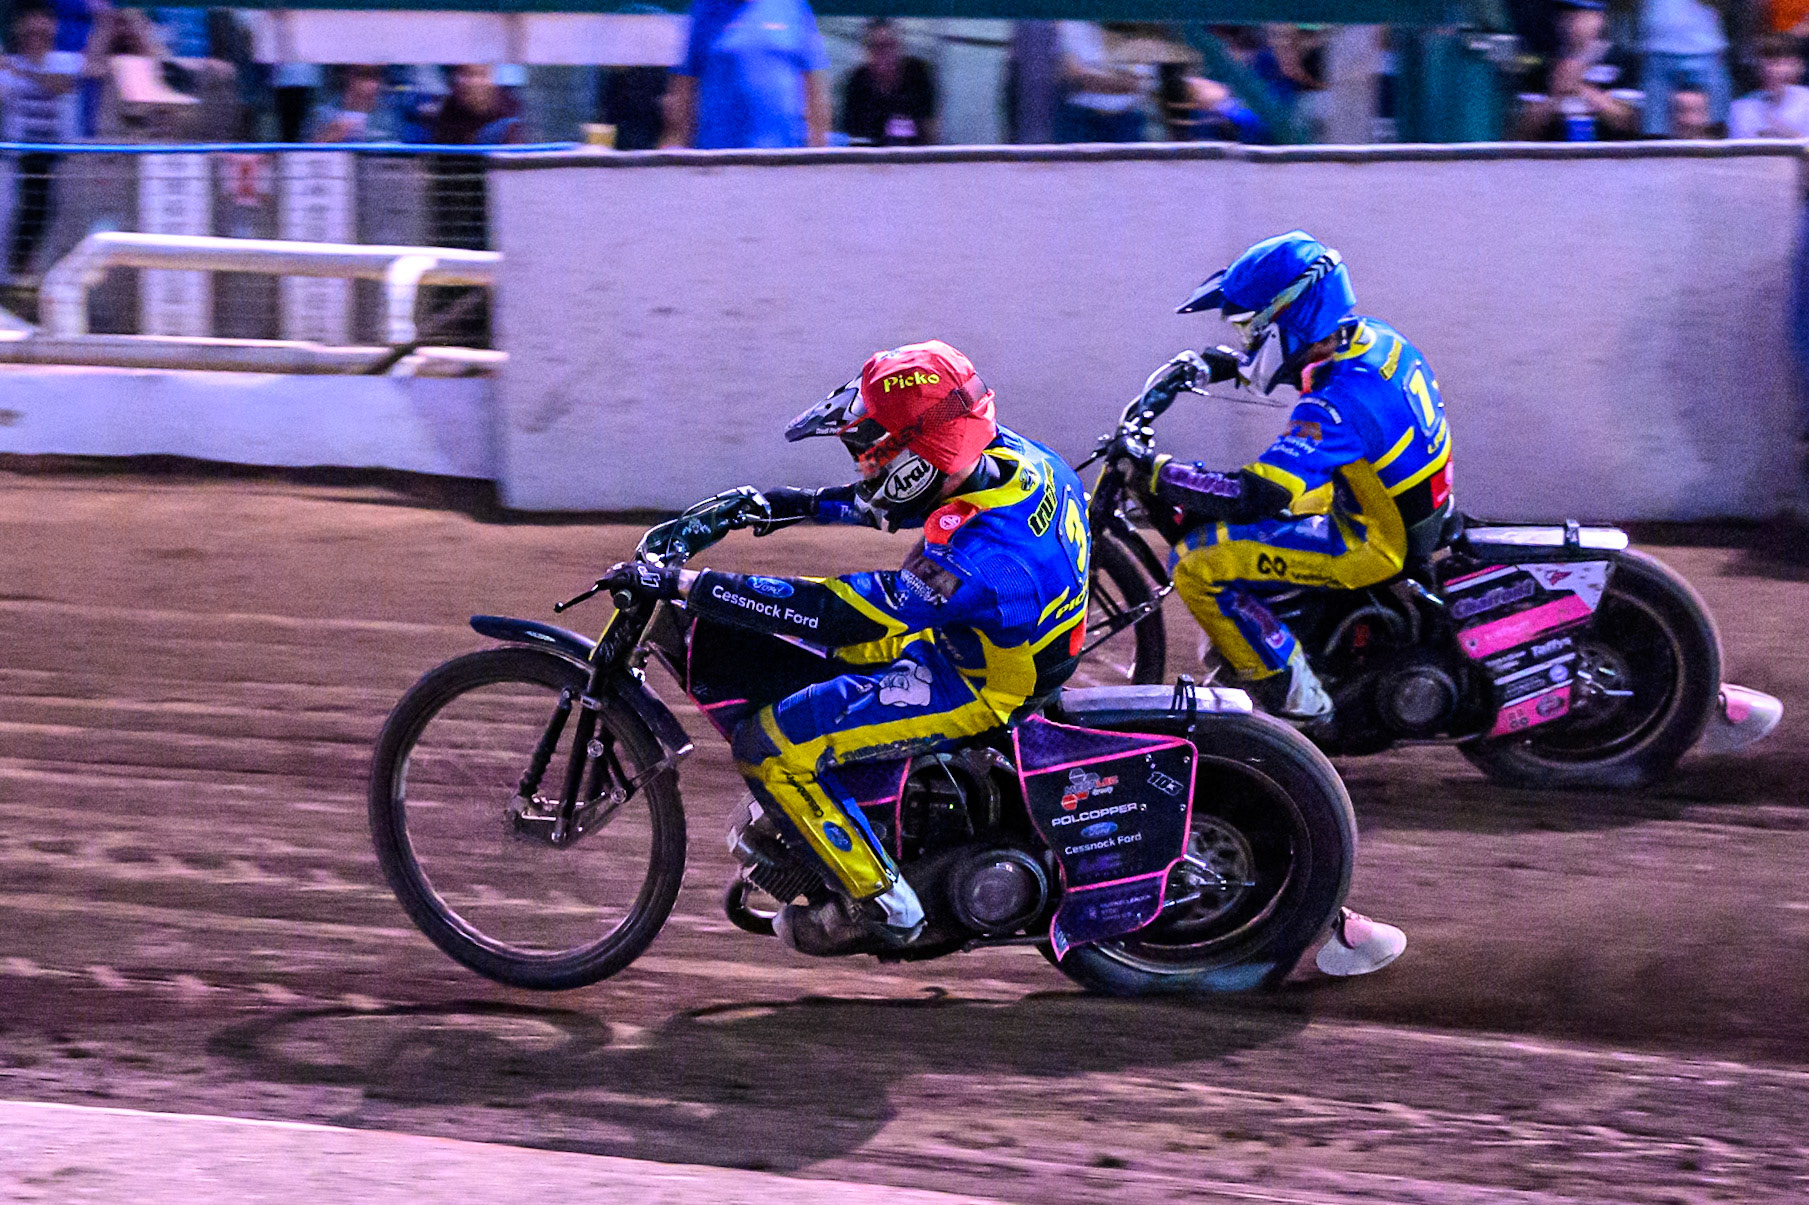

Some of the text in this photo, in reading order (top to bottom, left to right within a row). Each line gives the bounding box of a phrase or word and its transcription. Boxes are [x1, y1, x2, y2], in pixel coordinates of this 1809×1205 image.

[883, 371, 940, 393] Picko
[1408, 368, 1436, 428] 1
[891, 457, 931, 499] Arai
[711, 584, 819, 630] Cessnock Ford
[1051, 802, 1138, 827] POLCOPPER
[1064, 832, 1142, 855] Cessnock Ford
